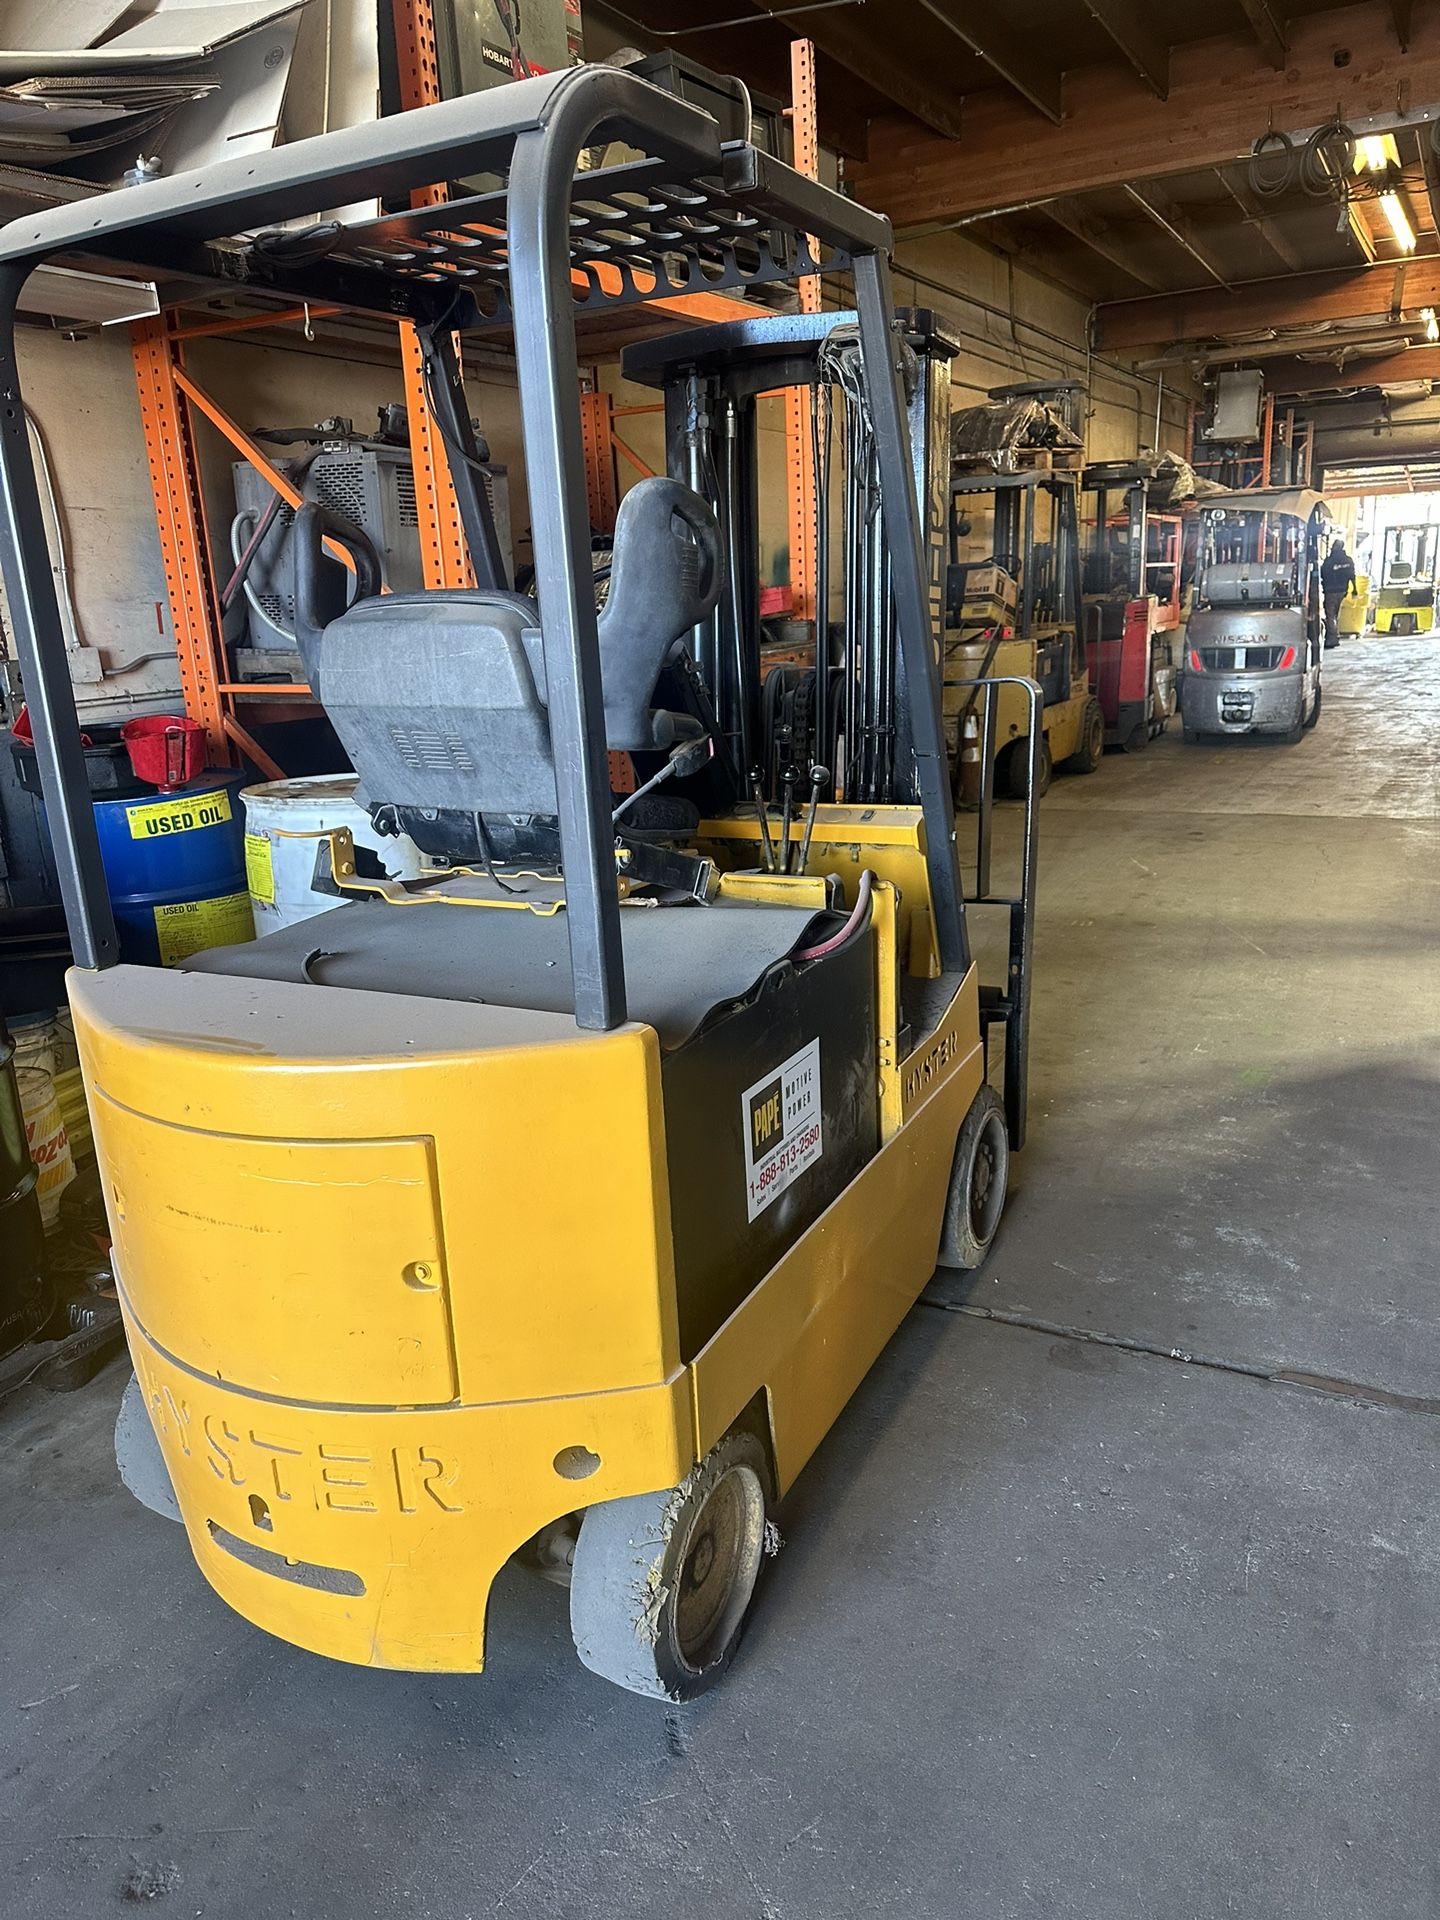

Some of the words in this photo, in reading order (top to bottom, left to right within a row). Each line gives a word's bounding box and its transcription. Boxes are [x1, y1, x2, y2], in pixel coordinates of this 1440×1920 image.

[482, 46, 513, 69] HOBART
[1215, 634, 1270, 644] NISSAN
[145, 812, 194, 835] USED
[199, 806, 223, 825] OIL
[162, 905, 185, 915] USED
[186, 904, 200, 913] OIL
[905, 1030, 958, 1104] HYSTER
[785, 1068, 812, 1099] MOTIVE
[787, 1090, 811, 1120] POWER
[750, 1124, 819, 1199] 1-888-813-2580
[756, 1194, 766, 1206] Sales
[789, 1164, 798, 1175] Parts
